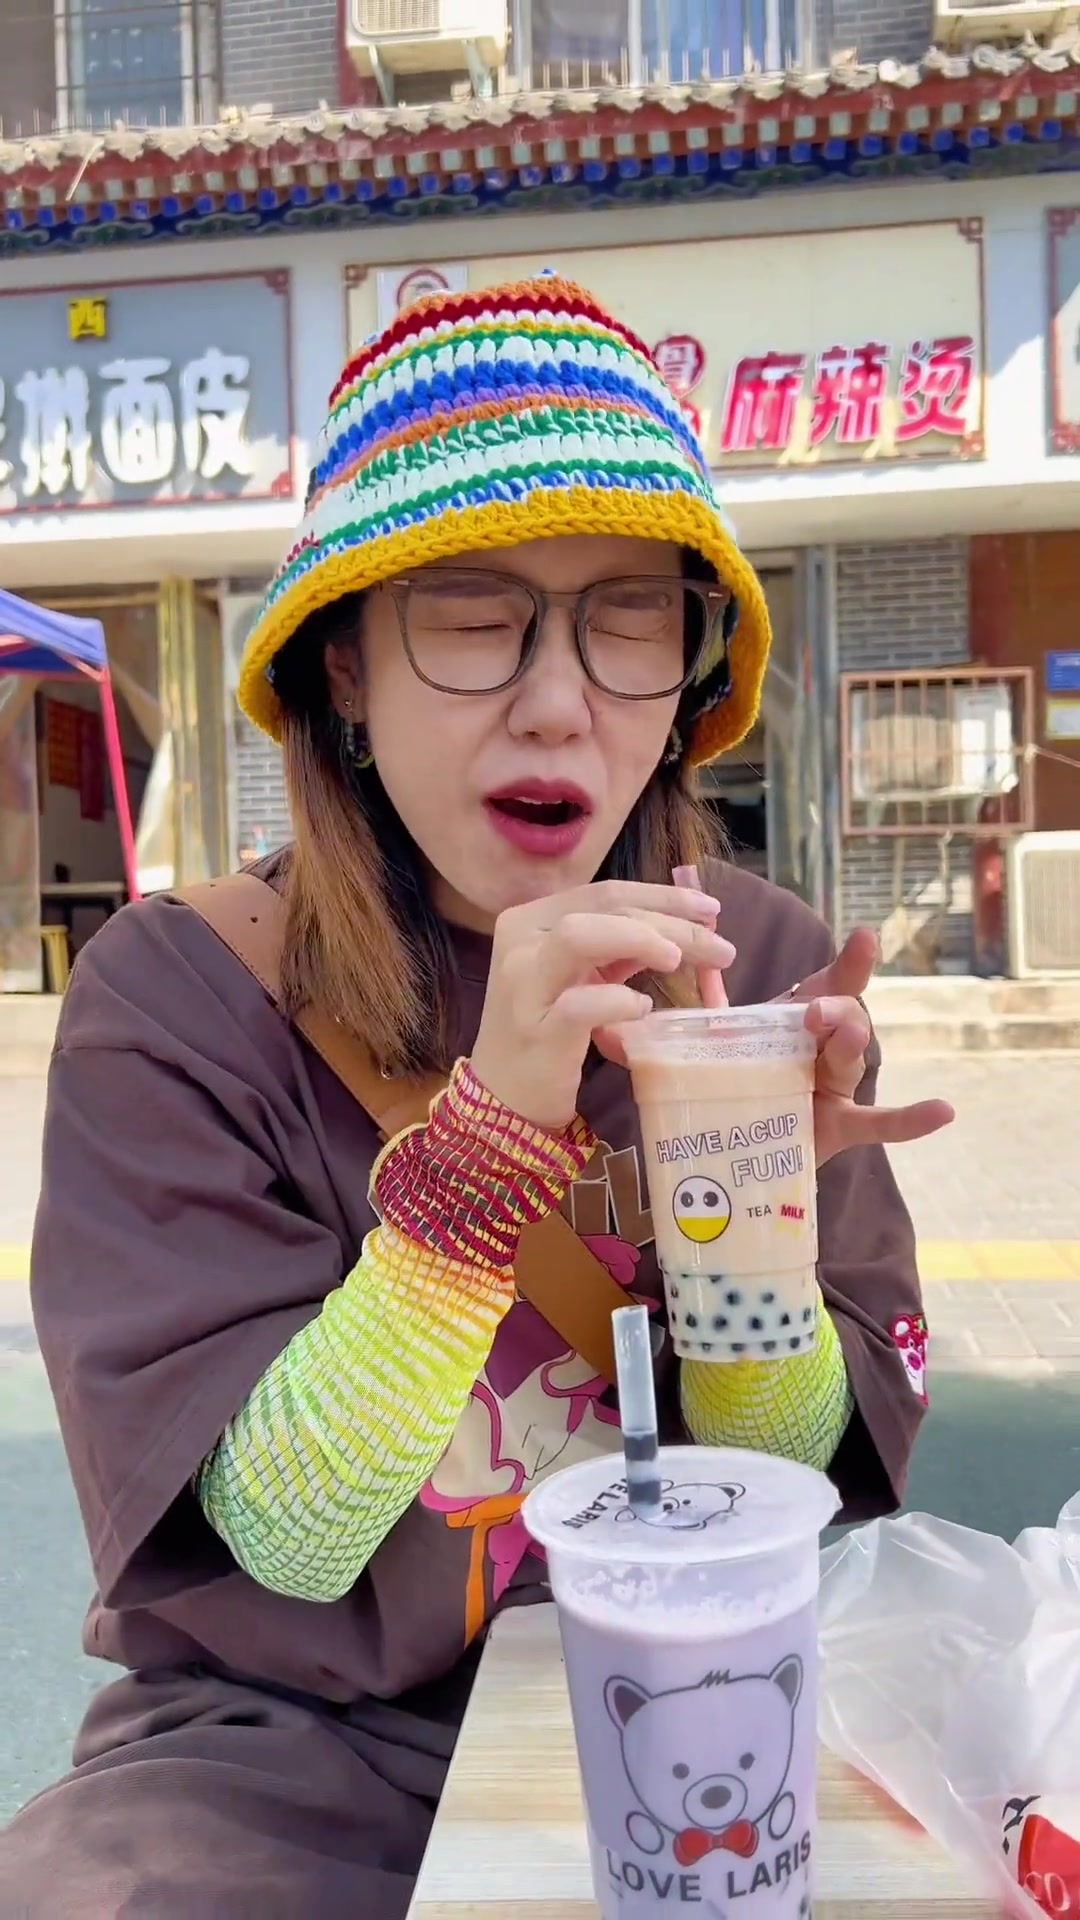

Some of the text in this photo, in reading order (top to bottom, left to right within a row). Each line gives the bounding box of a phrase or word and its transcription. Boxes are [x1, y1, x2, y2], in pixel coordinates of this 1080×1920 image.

[721, 336, 977, 453] 麻辣烫
[0, 347, 251, 496] 擀面皮
[656, 1113, 798, 1163] HAVE A CUP
[731, 1145, 803, 1187] FUN!
[746, 1204, 805, 1220] TEA MILK
[562, 1491, 620, 1529] LARIS
[606, 1830, 811, 1902] LOVE LARIS
[1024, 1871, 1080, 1911] CO
